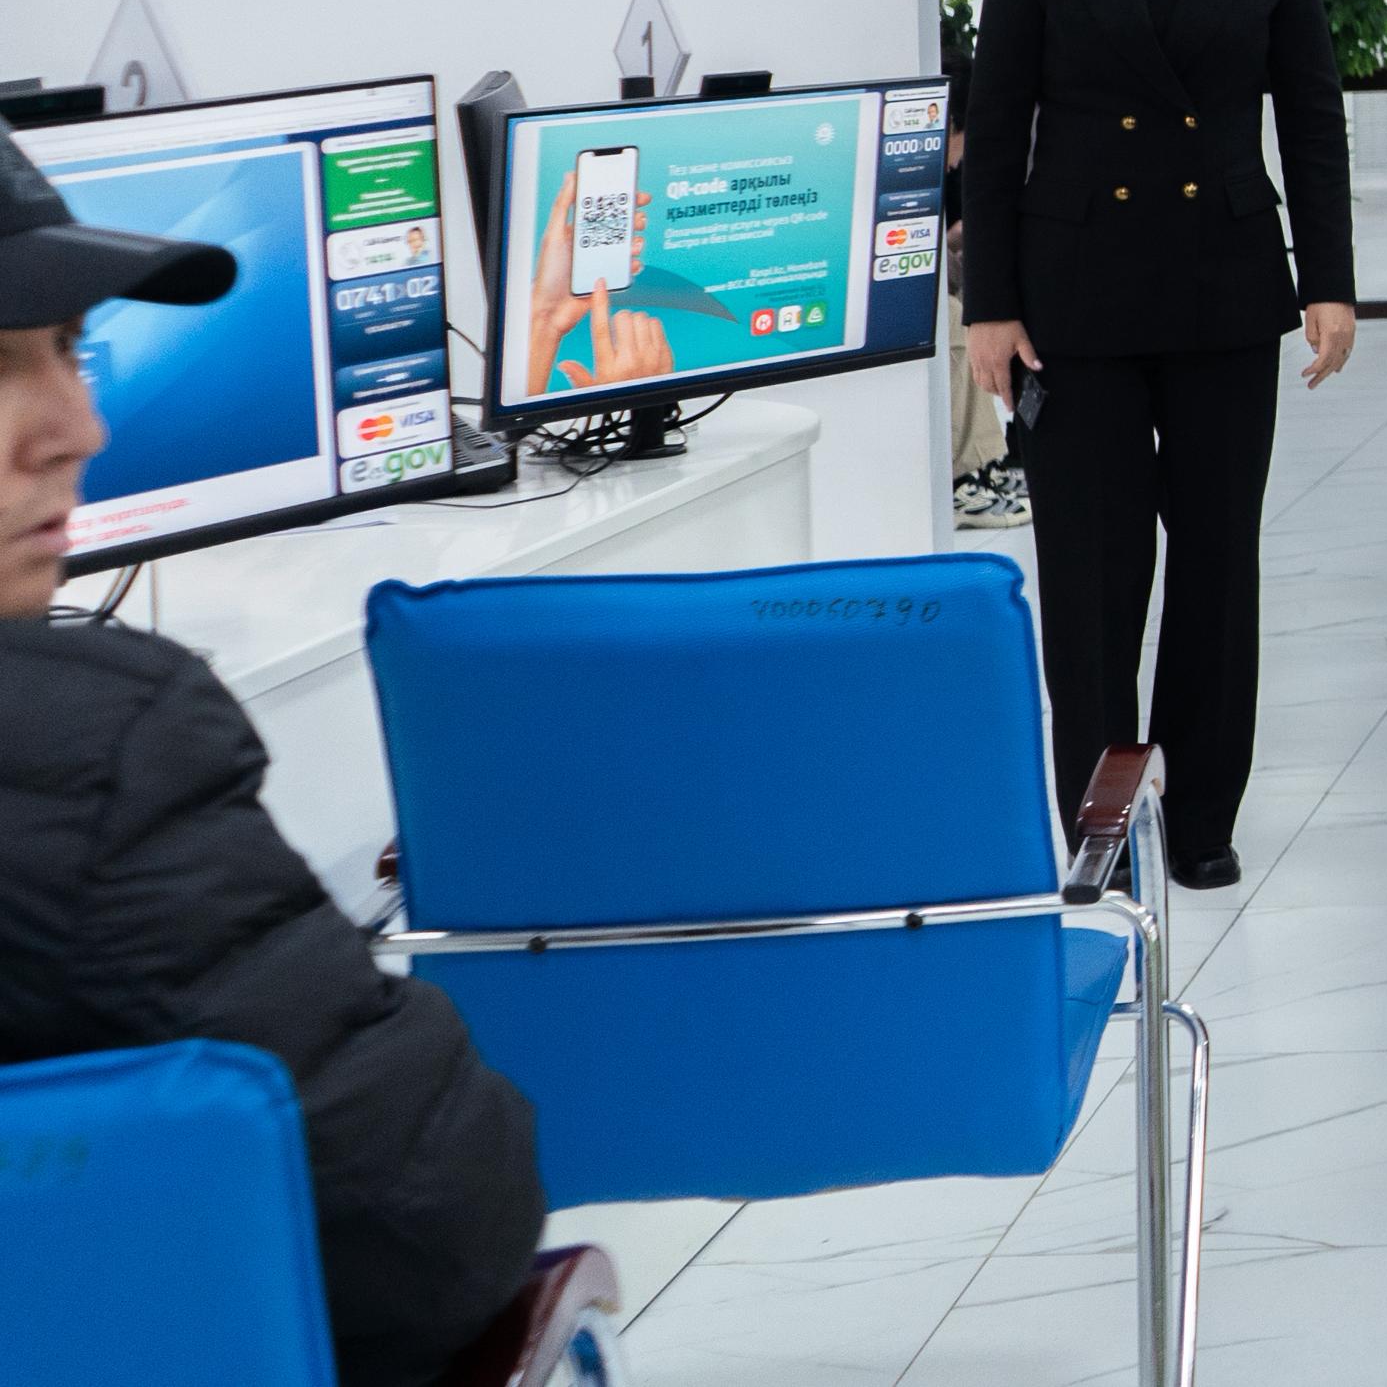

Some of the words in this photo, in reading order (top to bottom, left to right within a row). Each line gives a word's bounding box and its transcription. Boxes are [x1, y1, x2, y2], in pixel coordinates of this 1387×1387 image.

[885, 141, 919, 156] 0000
[924, 136, 941, 152] 00
[666, 177, 728, 200] QR-code
[730, 173, 792, 194] арқылы
[666, 194, 762, 223] қызметтерді
[765, 188, 818, 209] төлеңіз
[910, 228, 931, 240] VISA
[400, 409, 435, 427] VISA
